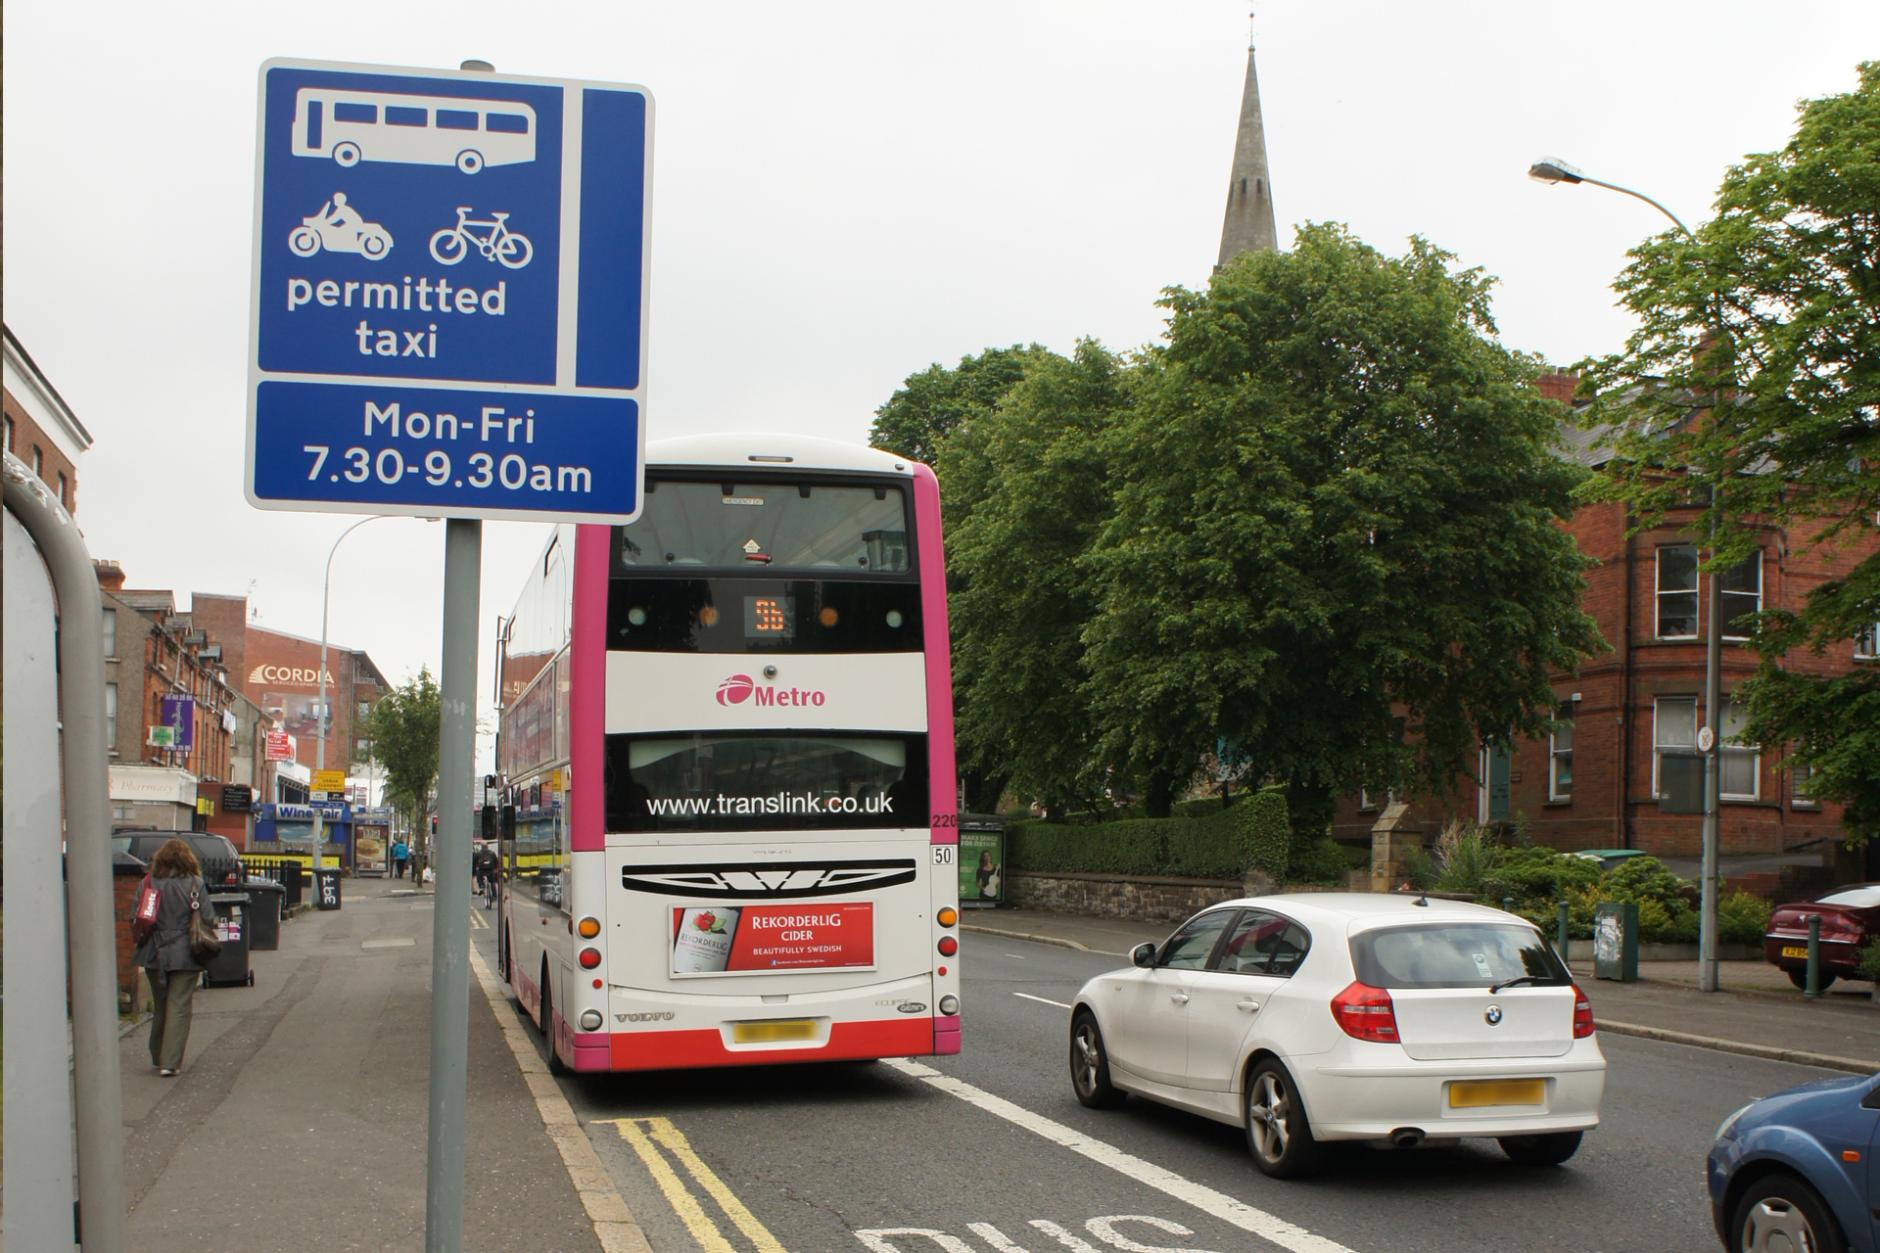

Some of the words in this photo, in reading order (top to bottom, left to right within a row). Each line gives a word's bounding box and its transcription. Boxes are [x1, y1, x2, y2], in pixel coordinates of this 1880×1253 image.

[287, 276, 507, 316] permitted
[355, 320, 438, 358] taxi
[364, 401, 535, 444] Mon-Fri
[303, 445, 592, 493] 7.30-9.30am
[264, 666, 335, 684] CORDIA
[755, 686, 825, 706] Metro
[646, 792, 894, 815] www.translink.co.uk
[935, 848, 951, 863] 50
[322, 875, 336, 904] 397
[752, 913, 841, 929] REKORDERLIG
[781, 930, 814, 941] CIDER
[753, 946, 804, 955] BEAUTIFULLY
[807, 945, 842, 953] SWEDISH
[614, 1012, 675, 1022] VOLVO
